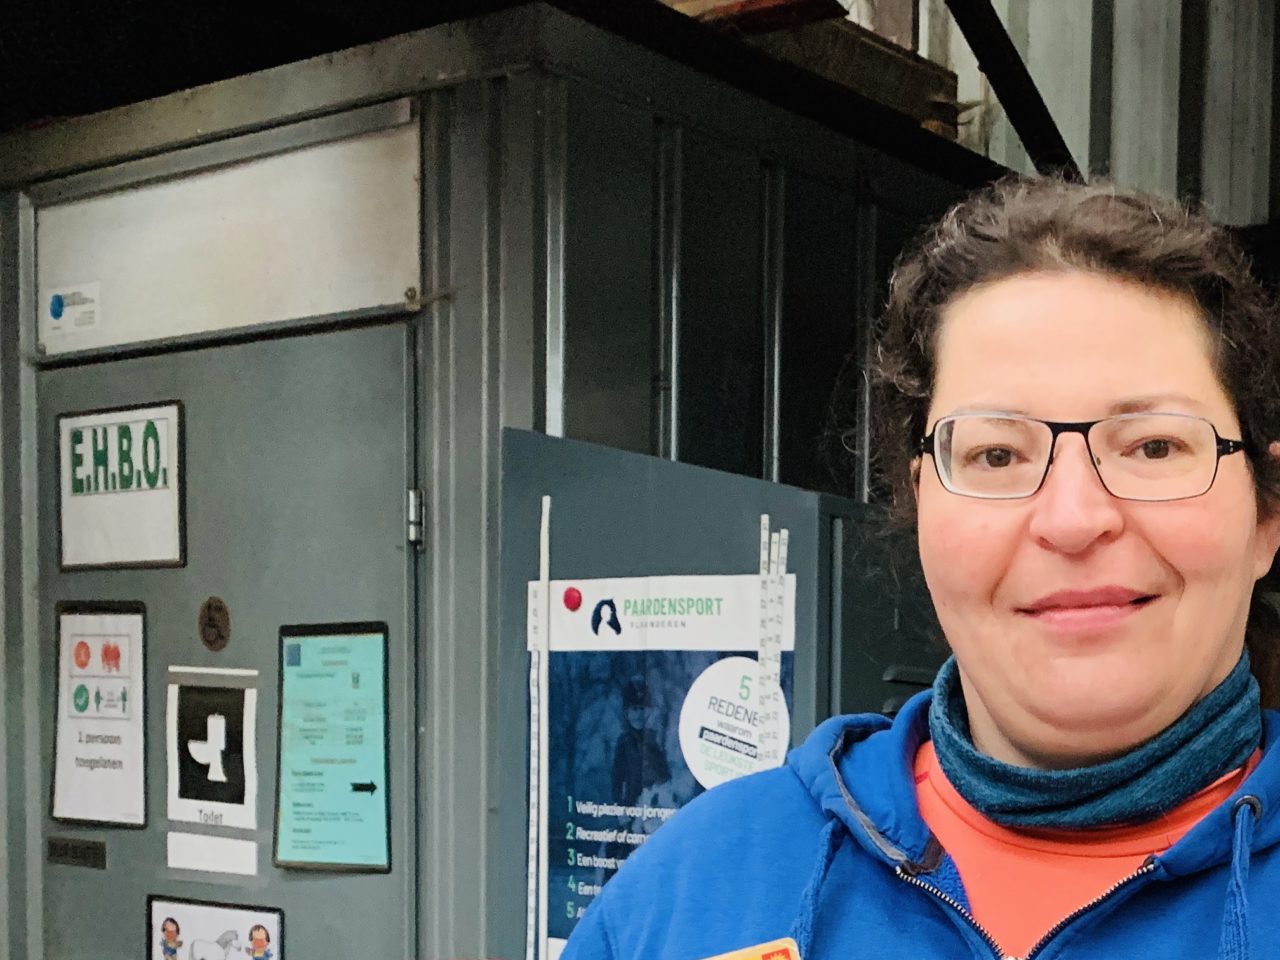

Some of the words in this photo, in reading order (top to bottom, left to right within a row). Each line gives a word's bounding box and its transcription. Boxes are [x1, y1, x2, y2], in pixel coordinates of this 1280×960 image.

[71, 420, 168, 494] E.H.B.O.
[623, 597, 724, 616] PAARDENSPORT
[739, 675, 752, 701] 5
[707, 695, 759, 728] REDENE
[567, 795, 573, 813] 1
[566, 822, 574, 840] 2
[567, 848, 575, 866] 3
[567, 875, 576, 892] 4
[566, 902, 575, 918] 5
